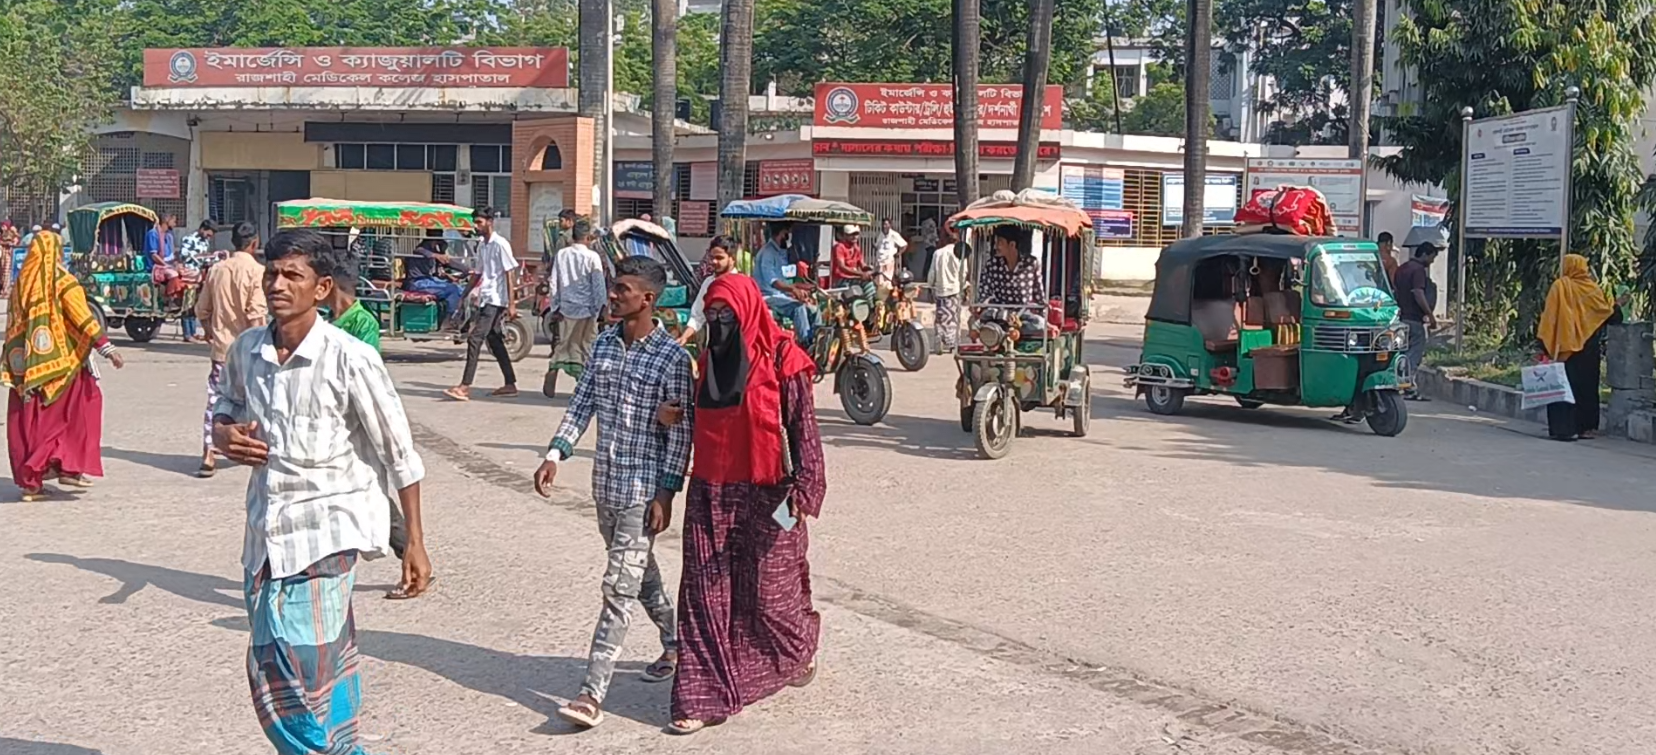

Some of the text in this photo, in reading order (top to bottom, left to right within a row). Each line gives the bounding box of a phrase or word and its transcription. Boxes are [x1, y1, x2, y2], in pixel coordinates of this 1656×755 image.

[204, 48, 545, 72] ইমার্জেন্সি ও ক্যাজুয়ালটি বিভাগ
[235, 71, 512, 84] রাজশাহী মেডিকেল কলেজ হাসপাতাল
[929, 89, 938, 97] ও
[864, 99, 888, 114] টিকিট
